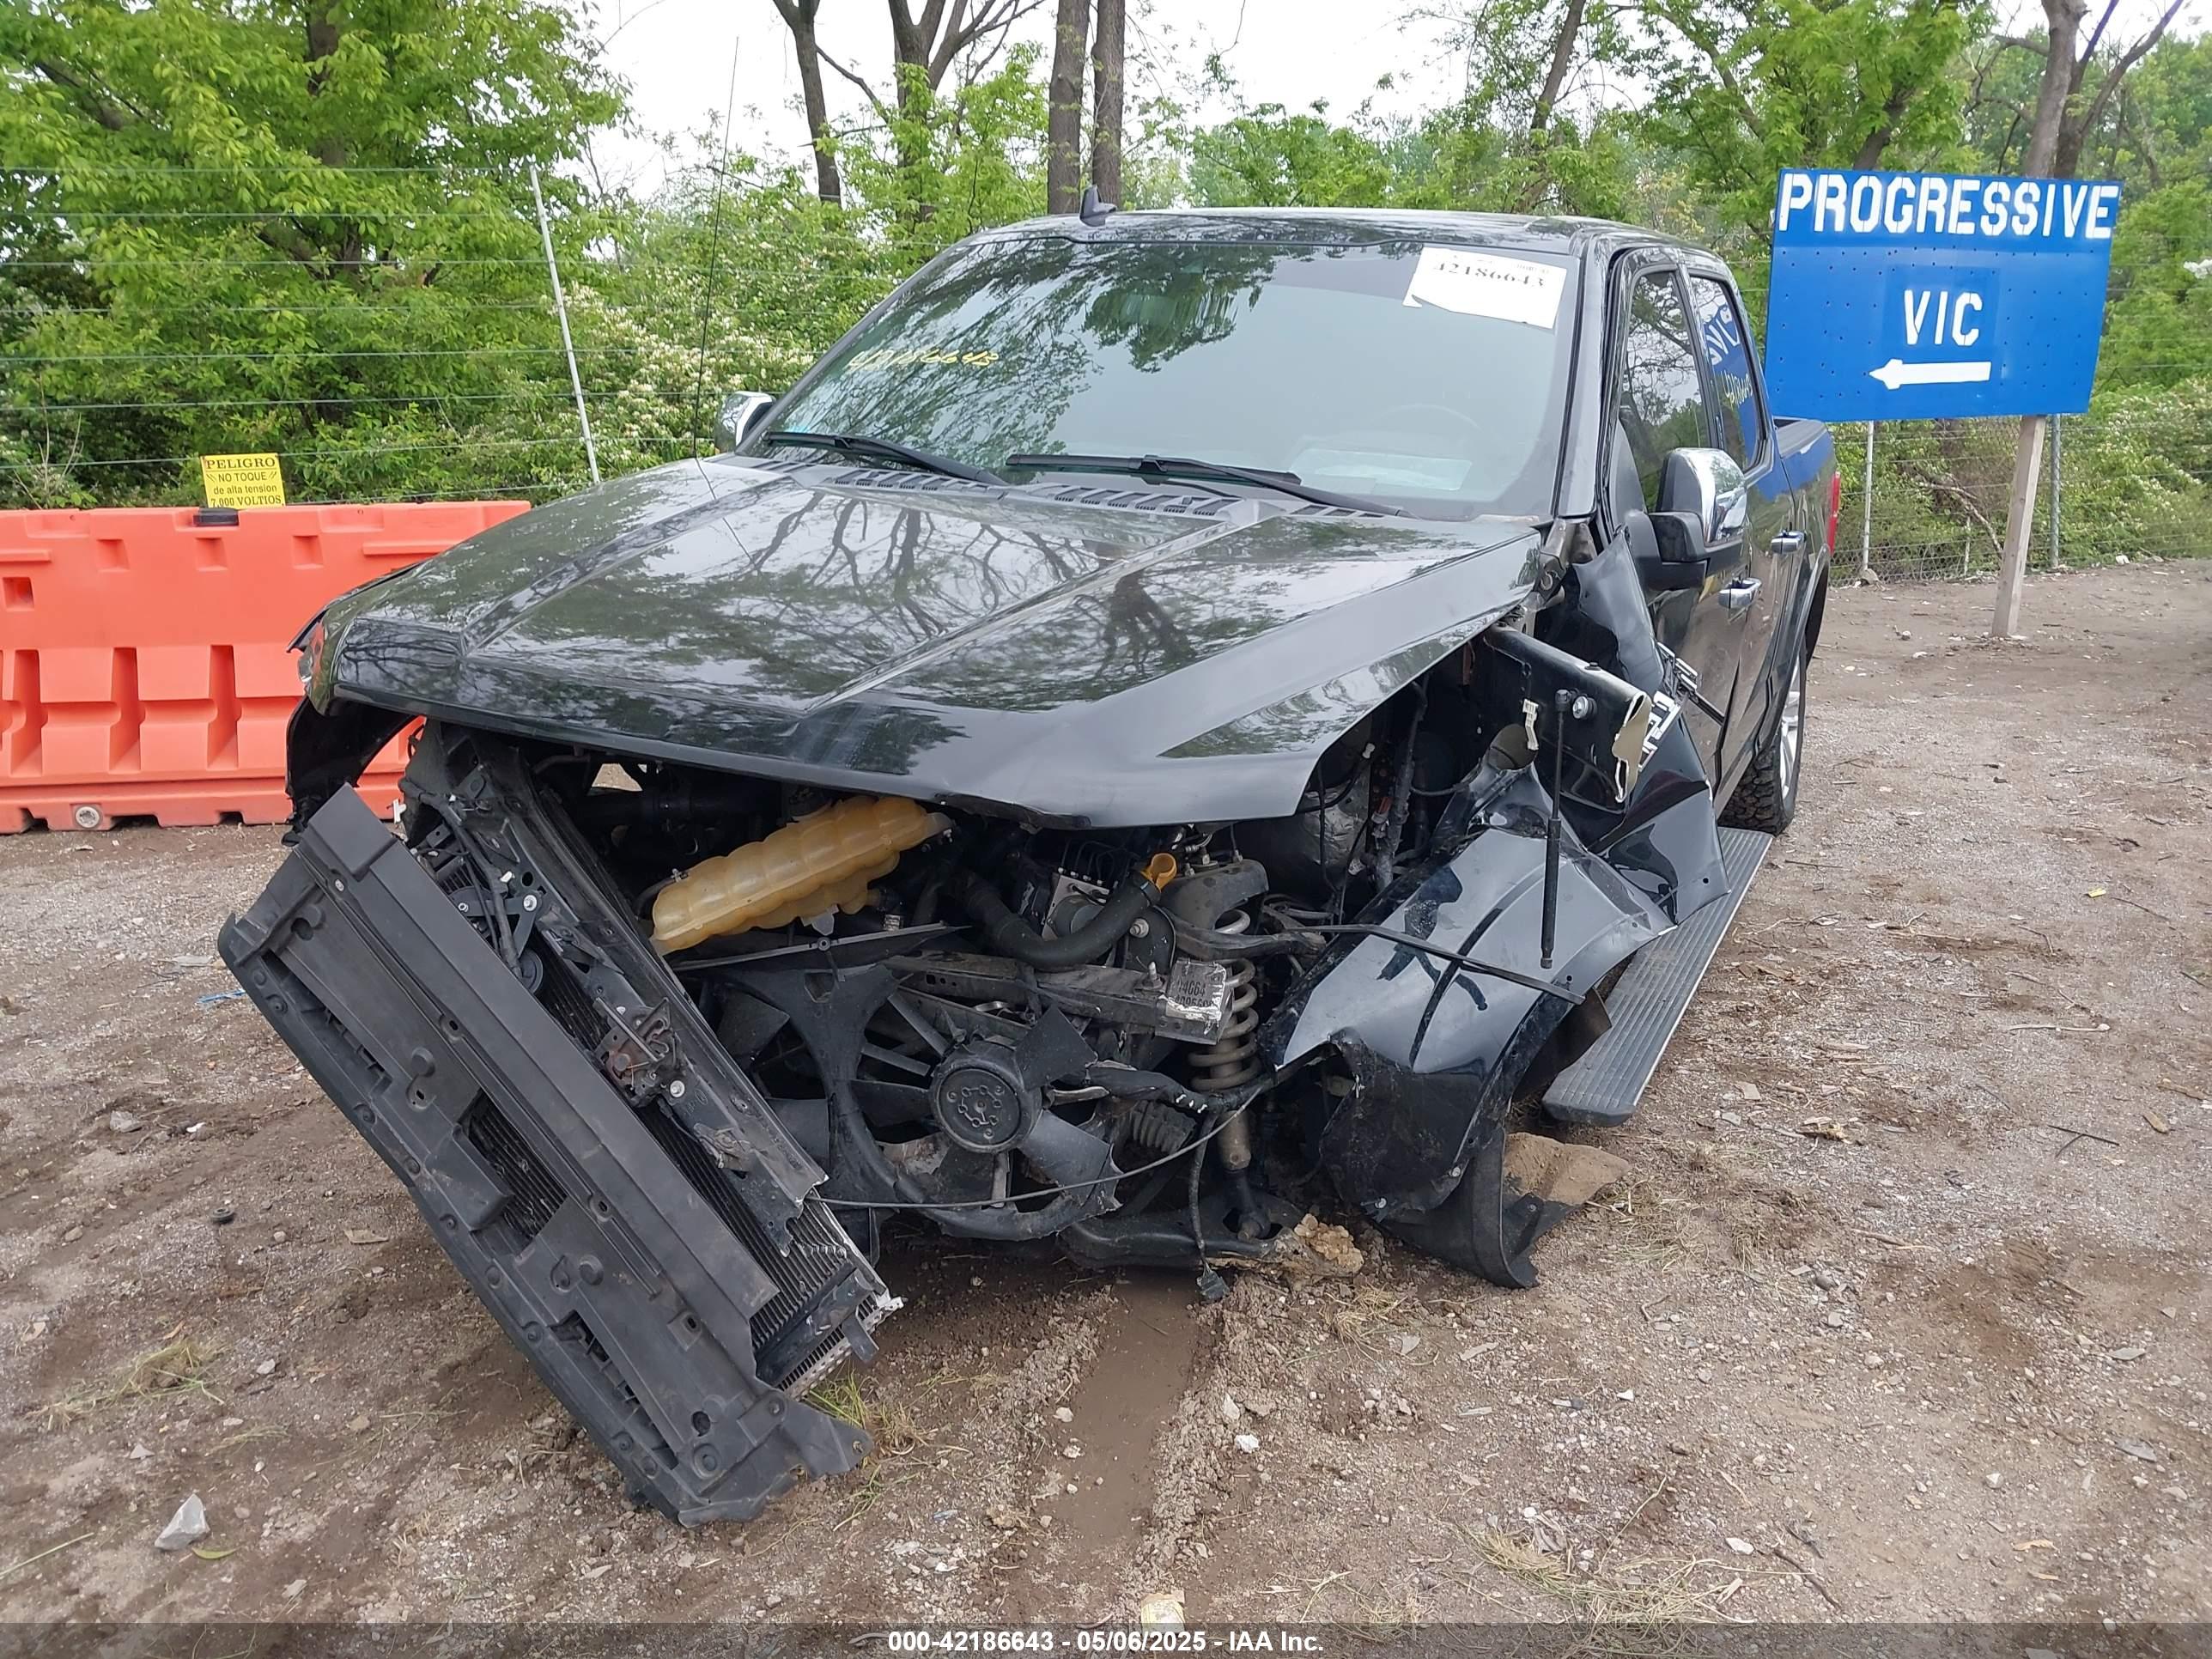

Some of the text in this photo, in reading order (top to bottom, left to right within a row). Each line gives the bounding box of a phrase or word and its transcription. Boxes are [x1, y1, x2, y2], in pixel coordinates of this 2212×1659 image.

[1778, 173, 2118, 239] PROGRESSIVE
[1904, 289, 1983, 346] VIC
[207, 458, 275, 469] PELIGRO
[218, 472, 266, 482] NO TOQUE
[227, 485, 243, 494] alta
[245, 483, 277, 493] tension
[237, 495, 281, 505] VOLTIOS
